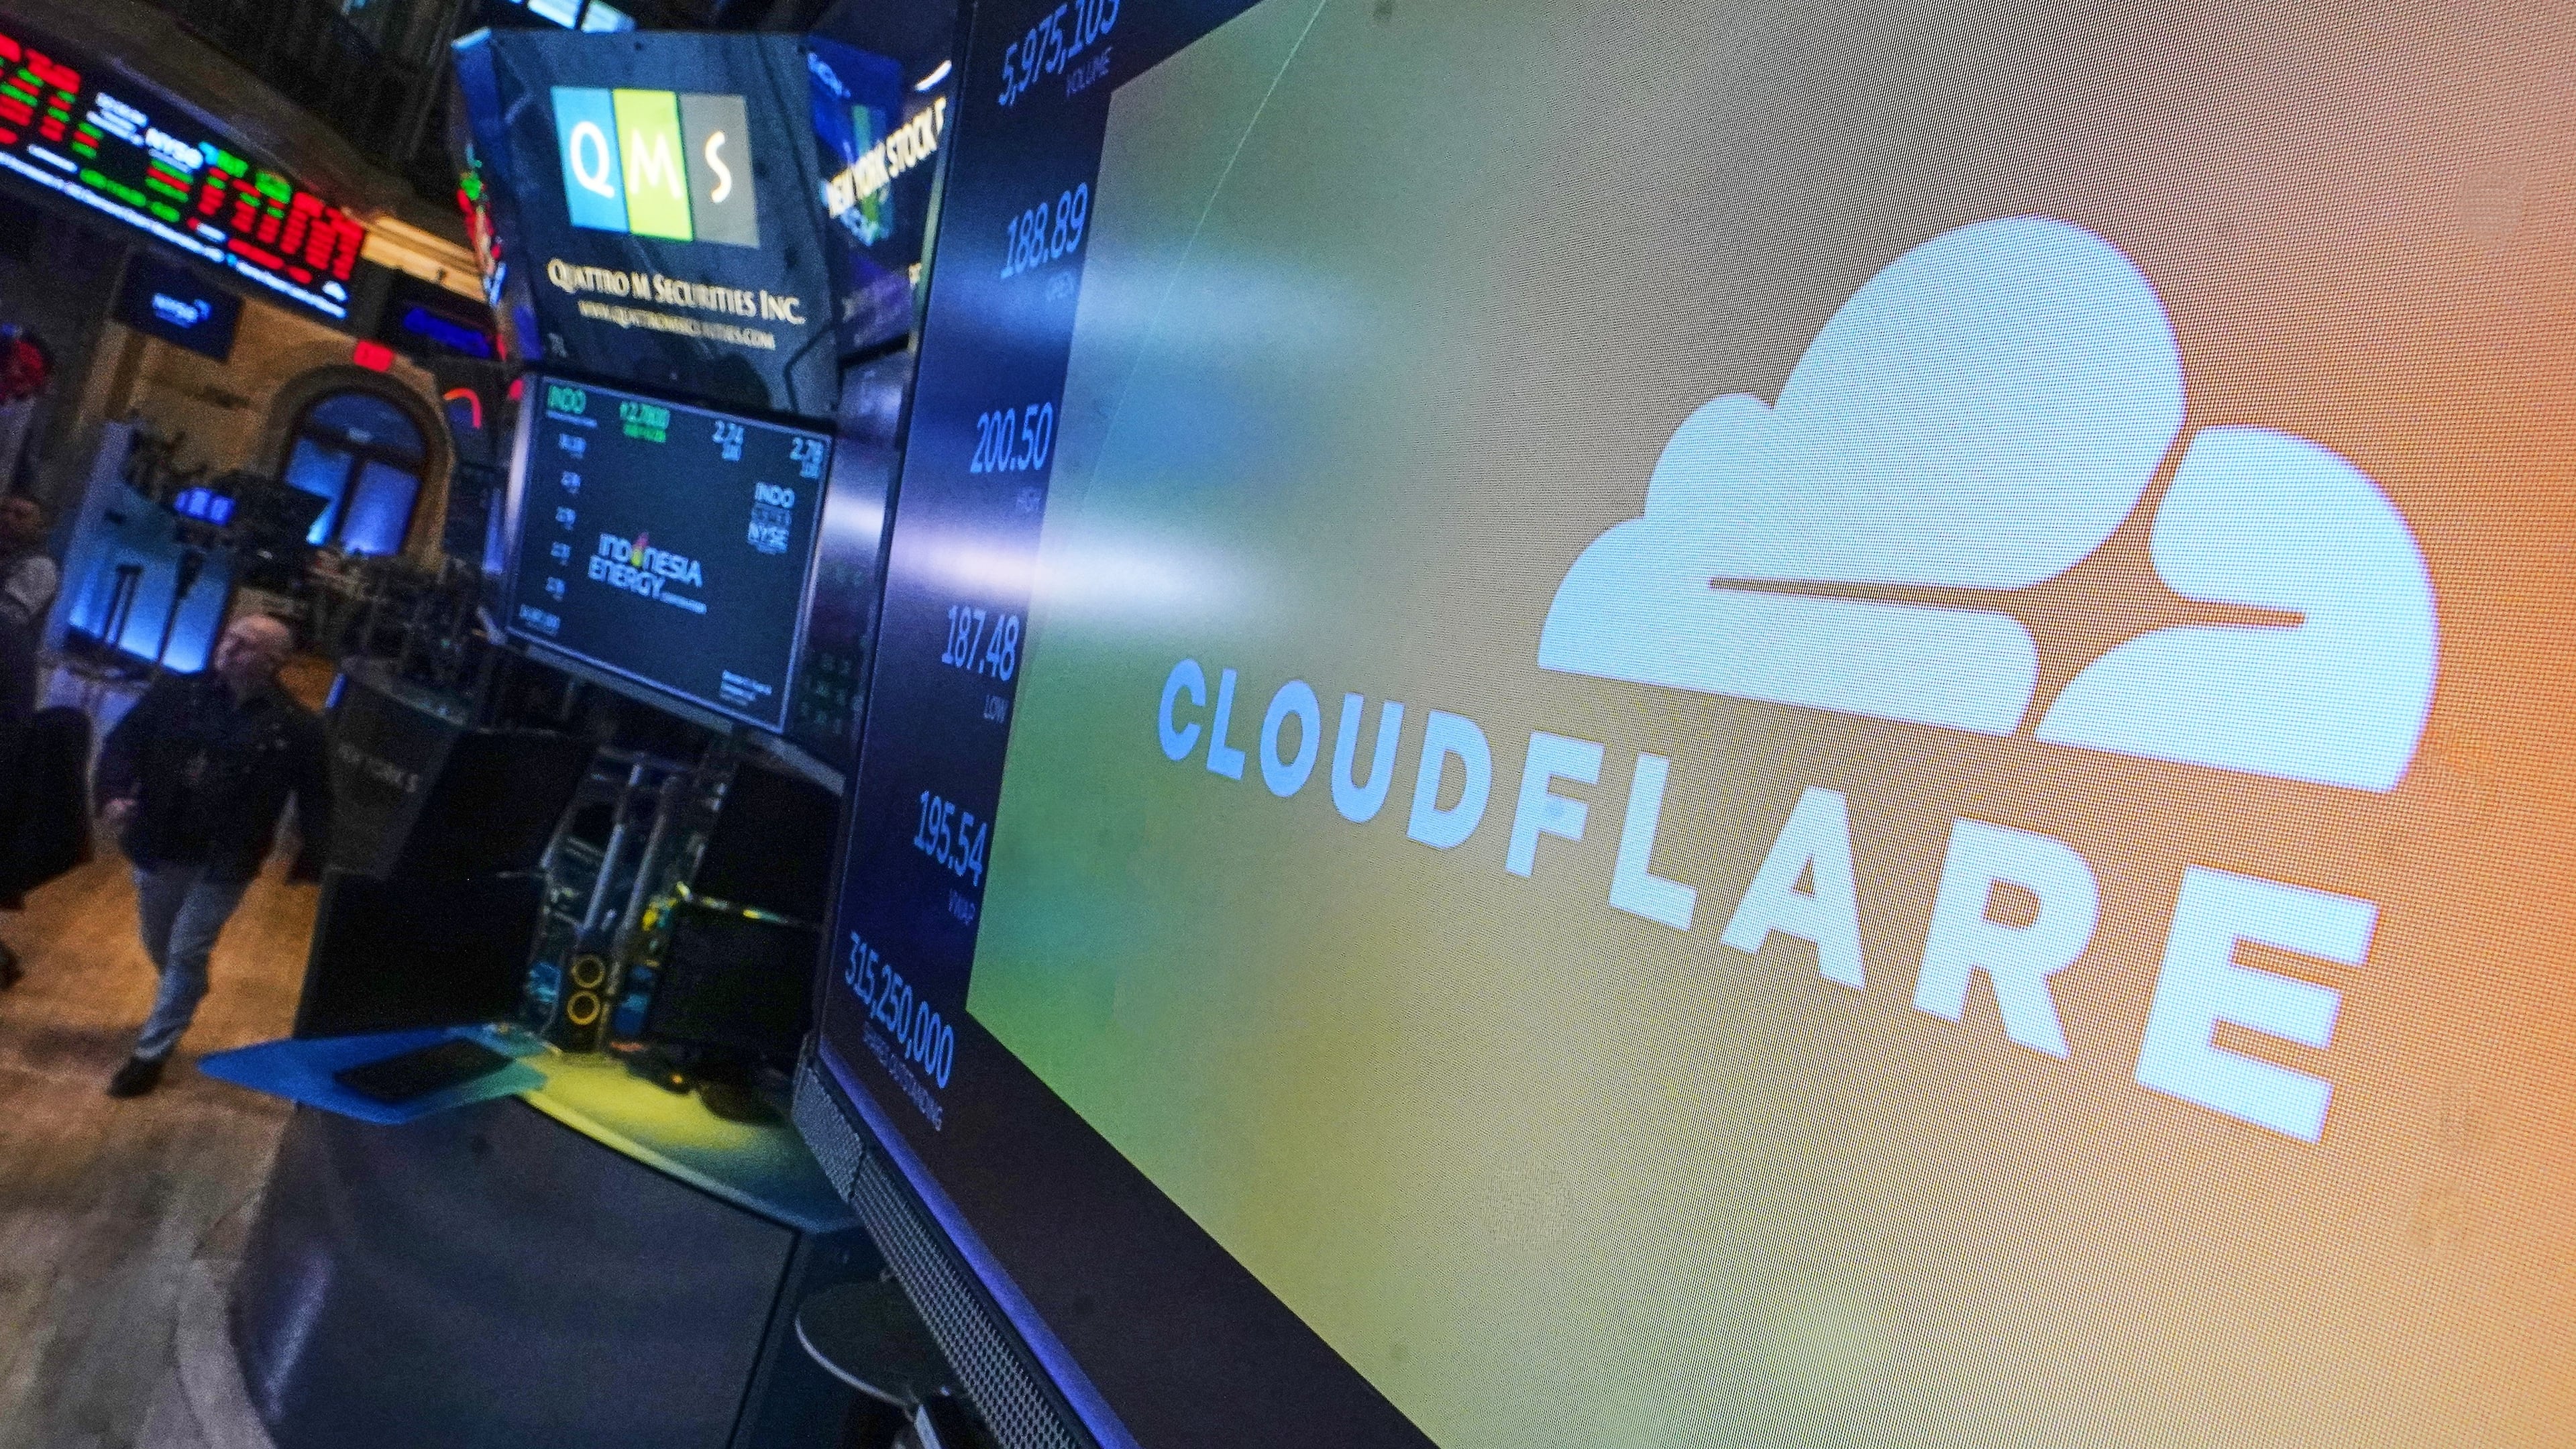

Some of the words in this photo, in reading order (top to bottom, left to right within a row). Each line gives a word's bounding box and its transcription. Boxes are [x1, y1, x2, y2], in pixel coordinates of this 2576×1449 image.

[853, 139, 890, 200] YORK
[886, 107, 937, 178] STOCK
[1000, 182, 1088, 280] 188.89
[630, 272, 651, 300] M
[652, 274, 757, 317] SECURITIES
[759, 290, 806, 324] INC.
[970, 402, 1053, 474] 200.50
[941, 605, 1020, 682] 187.48
[983, 694, 1008, 724] LOW
[914, 790, 987, 888] 195.54
[1158, 657, 2379, 1144] CLOUDFLARE
[845, 931, 954, 1089] 315,250,000
